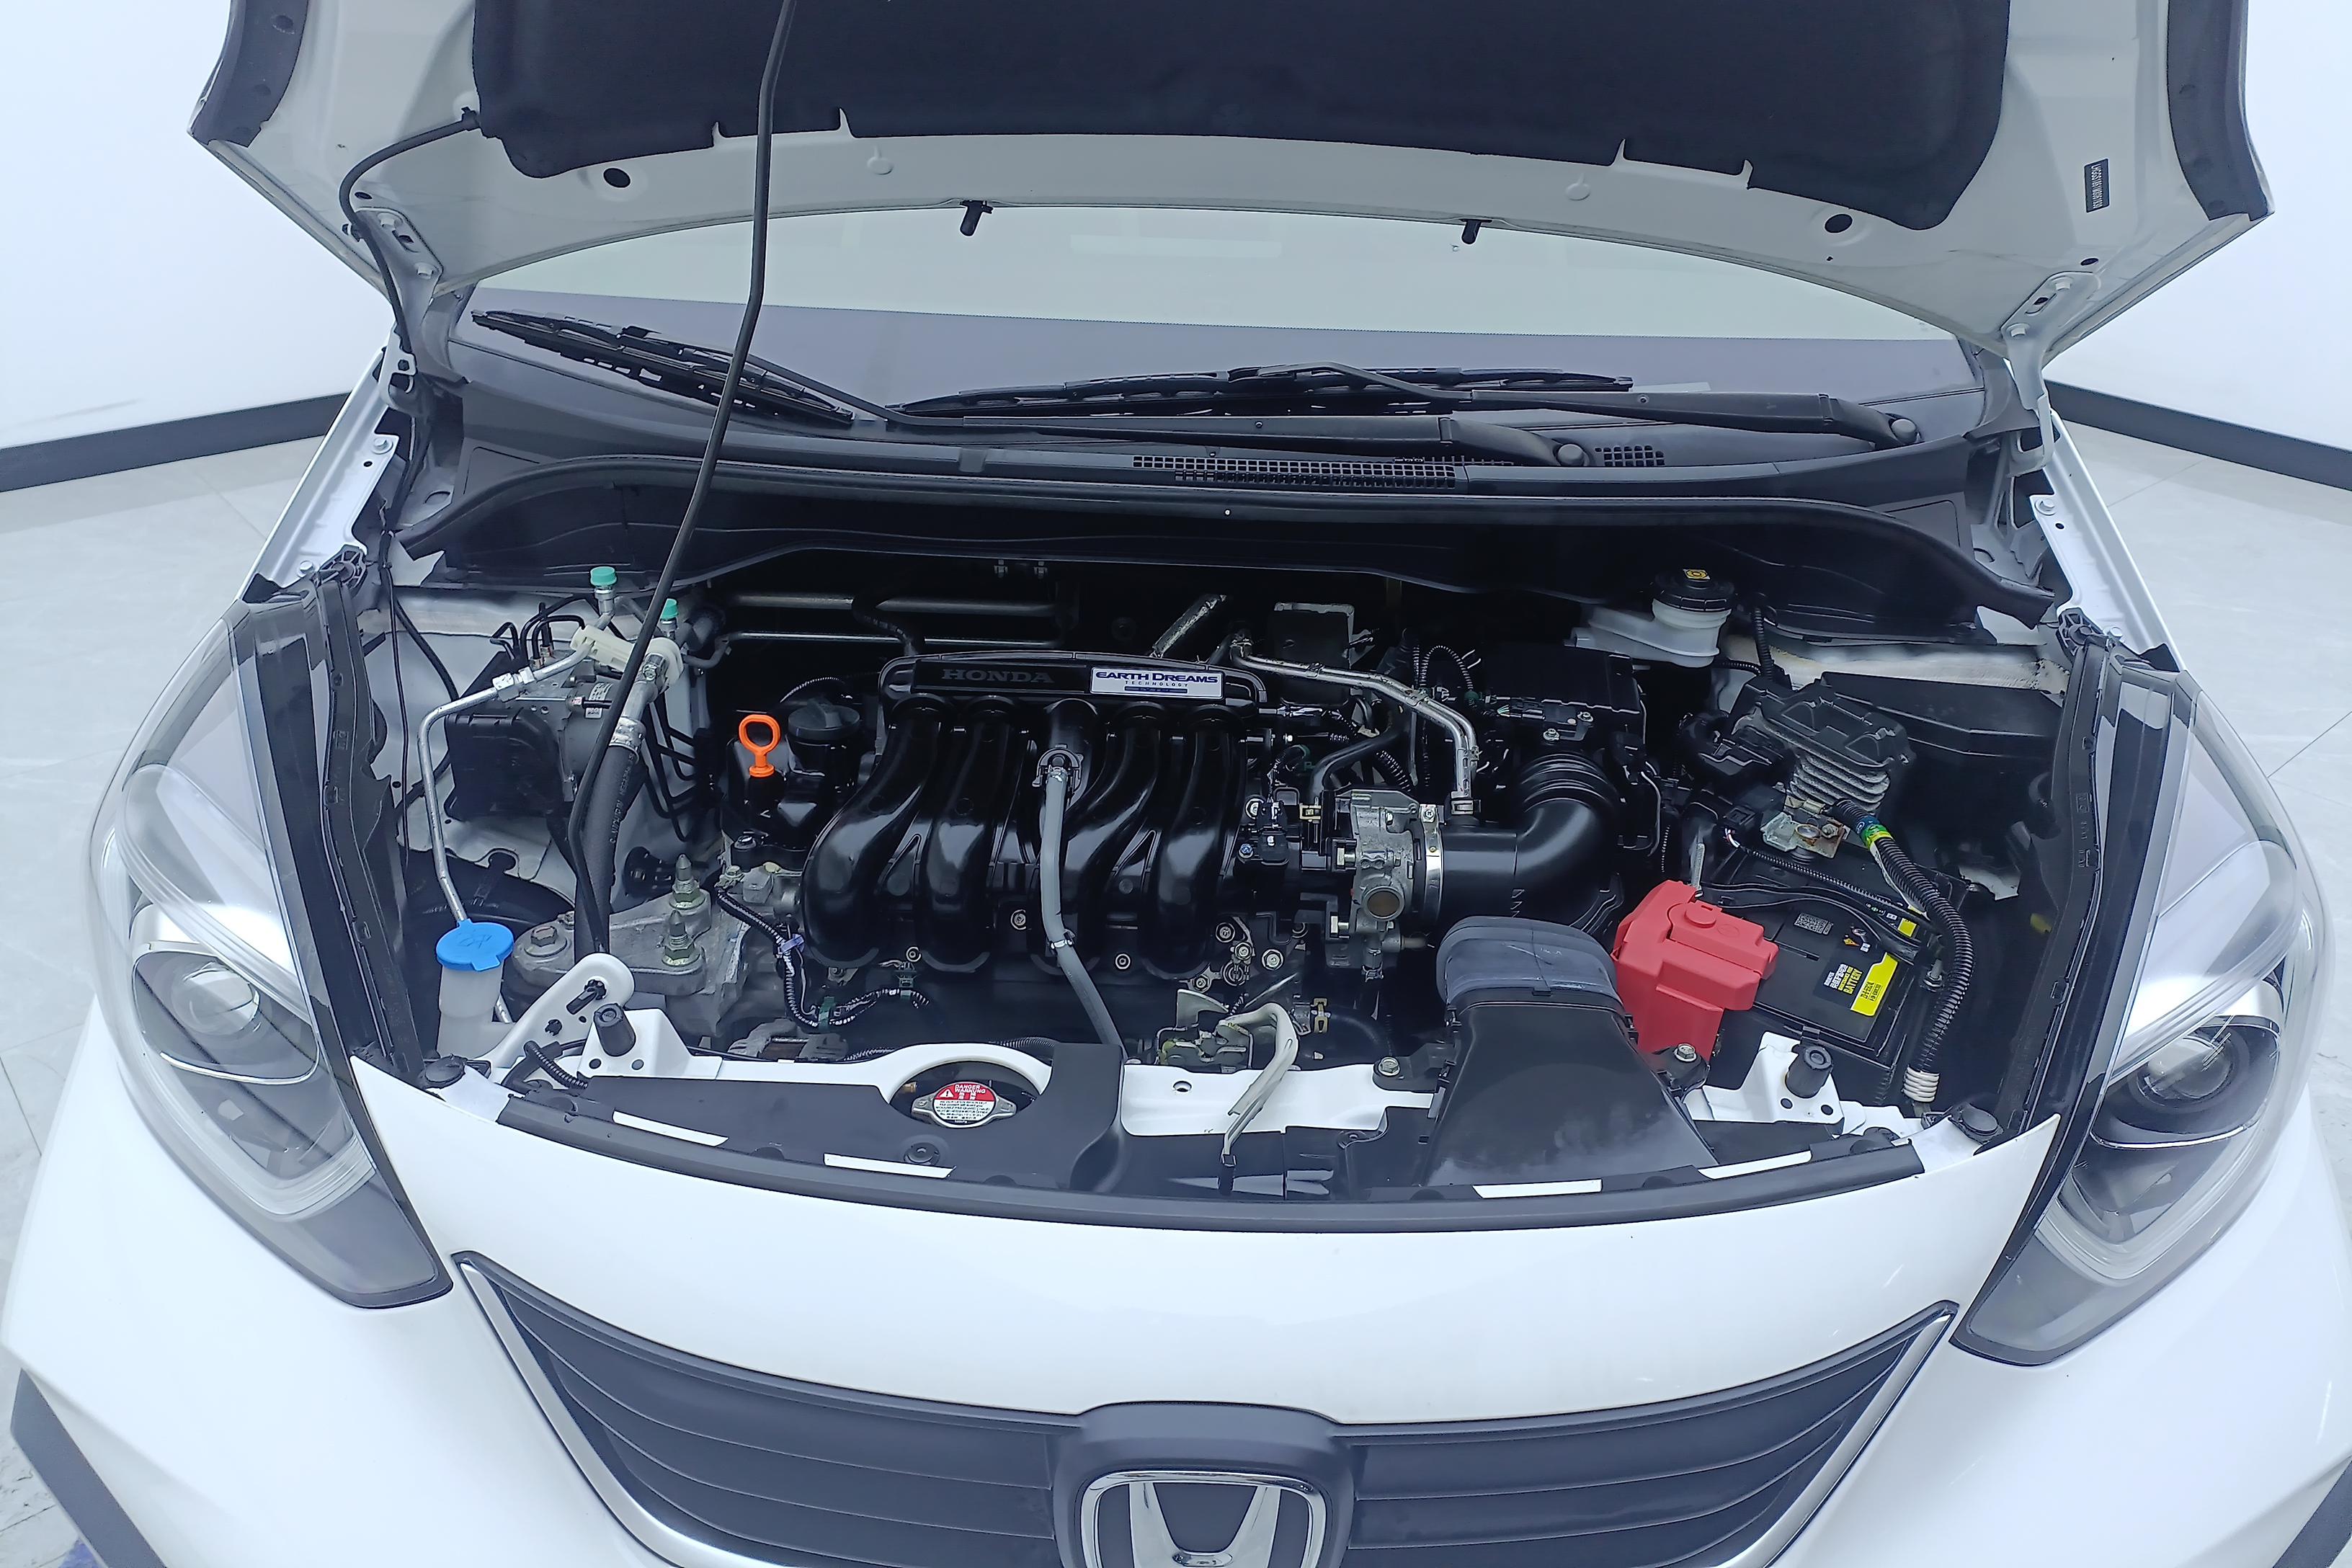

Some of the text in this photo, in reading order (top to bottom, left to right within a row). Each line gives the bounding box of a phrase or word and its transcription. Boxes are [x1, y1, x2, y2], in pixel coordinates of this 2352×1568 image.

[943, 669, 1054, 683] HONDA
[1096, 671, 1219, 684] EARTH DREAMS
[1843, 968, 1863, 994] BATTERY
